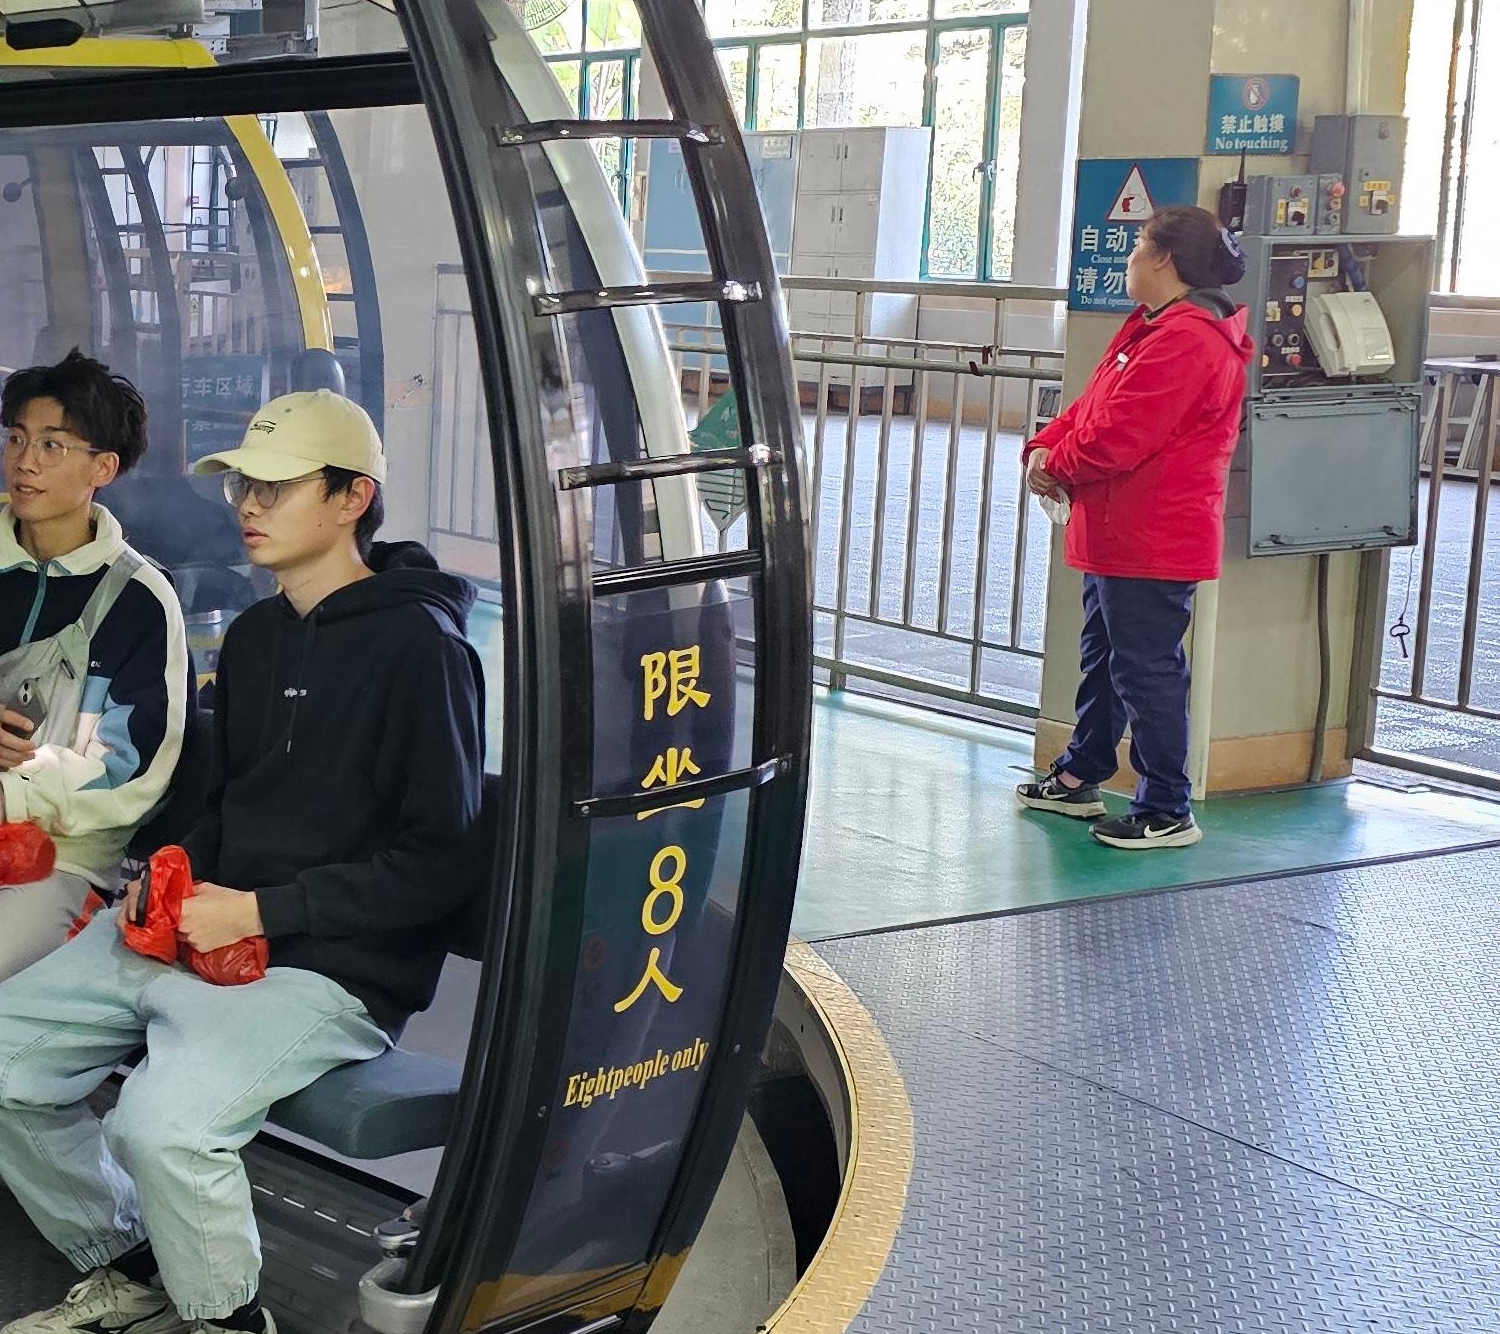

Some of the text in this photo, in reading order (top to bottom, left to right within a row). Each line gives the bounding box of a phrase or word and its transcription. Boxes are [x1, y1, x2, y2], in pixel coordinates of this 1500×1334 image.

[1220, 113, 1285, 134] 禁止触摸
[1215, 136, 1288, 152] No touching
[1076, 266, 1125, 295] 请勿
[1080, 295, 1093, 305] Do
[670, 1037, 710, 1072] only
